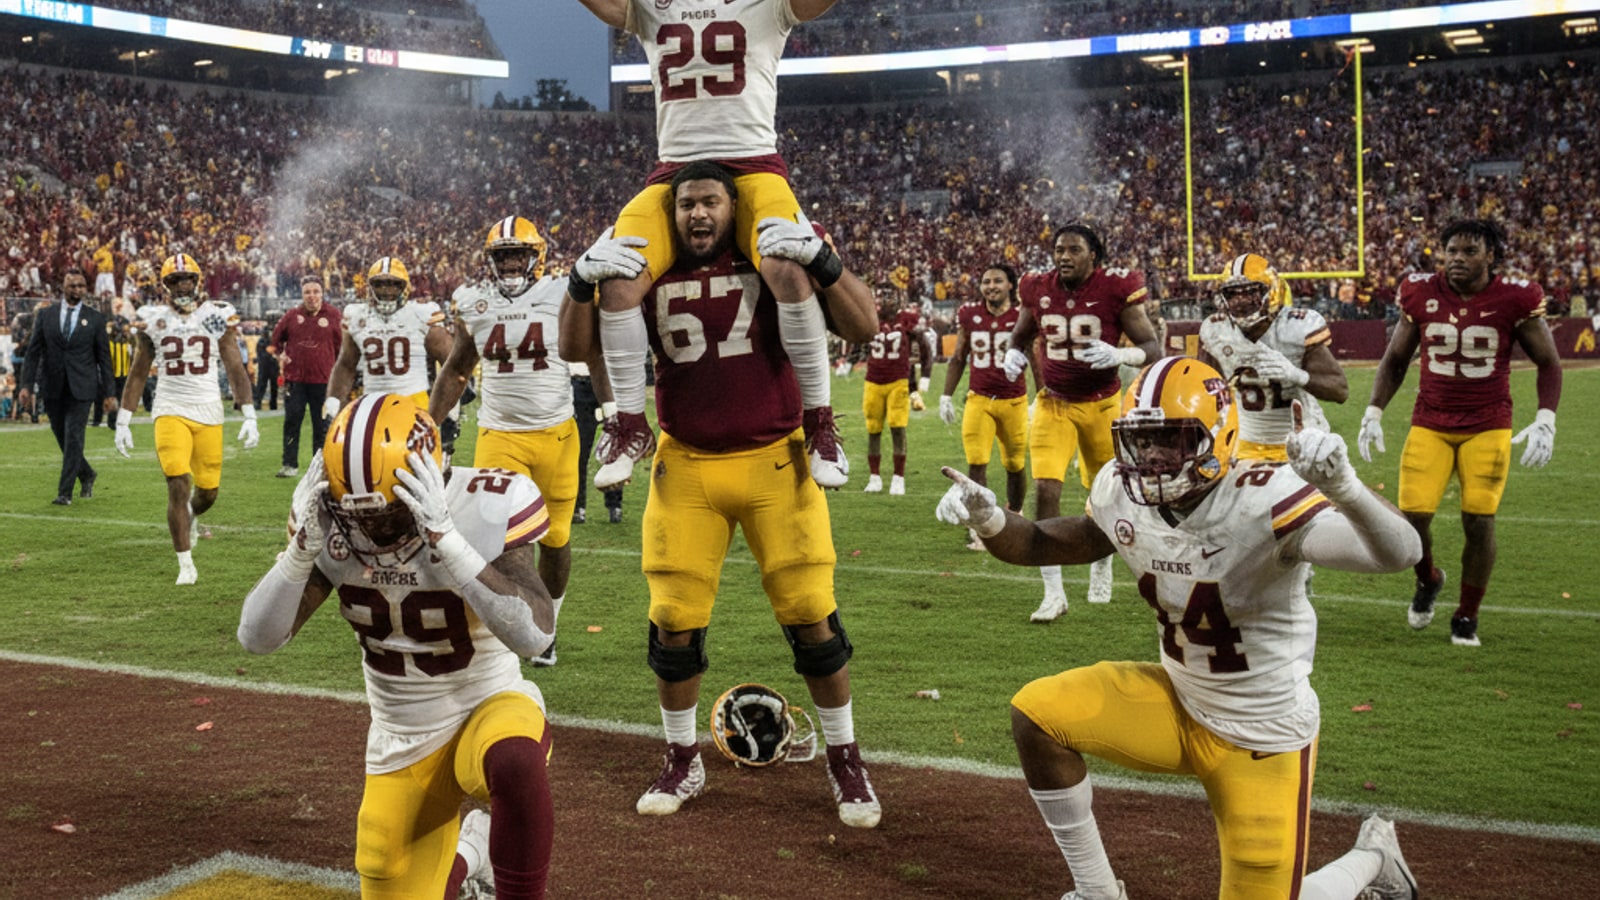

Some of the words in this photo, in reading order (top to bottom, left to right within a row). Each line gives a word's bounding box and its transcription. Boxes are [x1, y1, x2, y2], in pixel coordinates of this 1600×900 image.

[656, 20, 746, 102] 29
[655, 271, 761, 364] 67
[161, 335, 210, 376] 23
[363, 336, 410, 376] 20
[483, 321, 549, 374] 44
[1425, 322, 1499, 379] 29
[338, 583, 476, 677] 29
